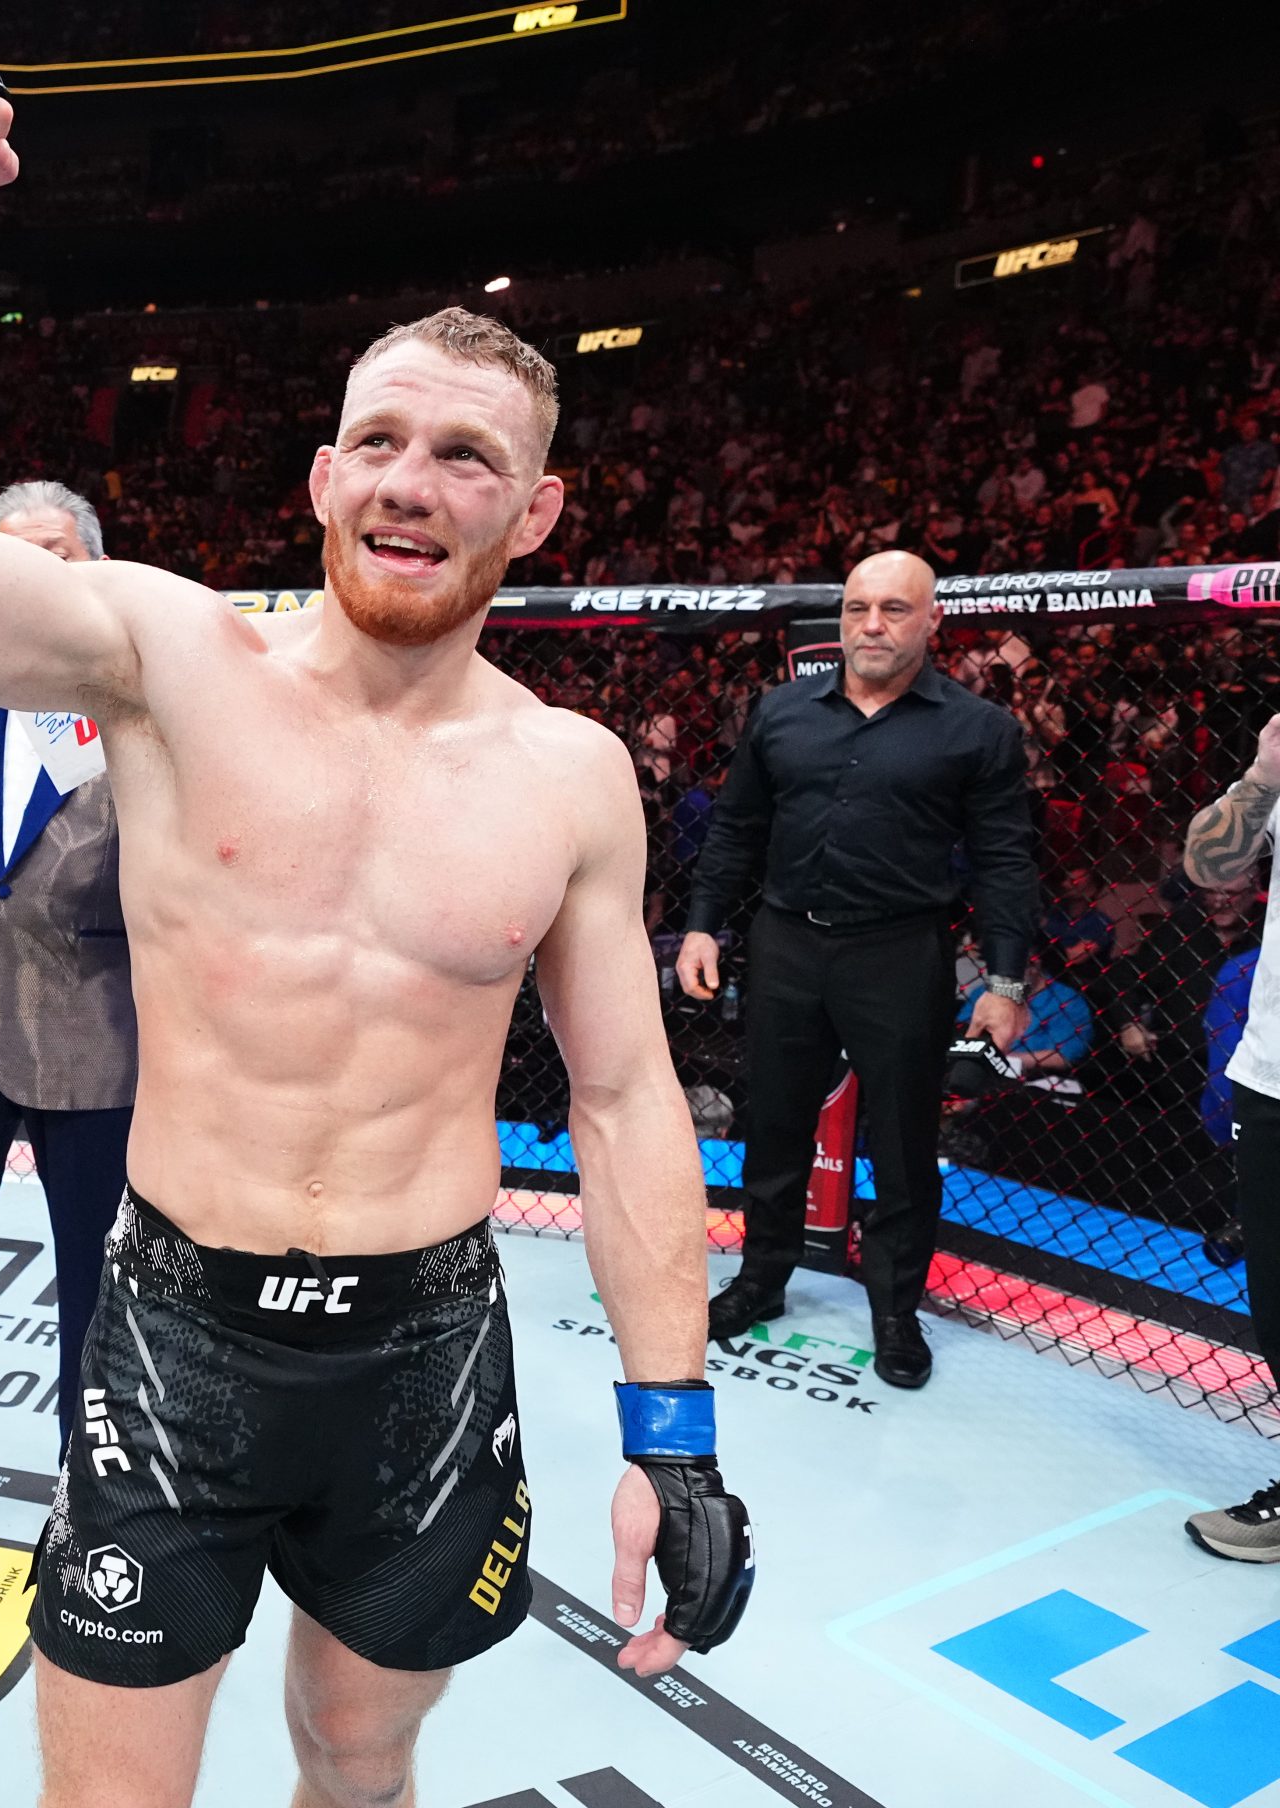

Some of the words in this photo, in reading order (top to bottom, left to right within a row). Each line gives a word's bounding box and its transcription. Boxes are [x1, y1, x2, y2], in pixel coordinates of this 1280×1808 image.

[989, 571, 1112, 591] DROPPED
[570, 589, 767, 612] #GETRIZZ
[1047, 588, 1157, 612] BANANA
[984, 1046, 1008, 1075] UFC
[258, 1275, 360, 1314] UFC
[83, 1388, 132, 1477] UFC
[469, 1479, 531, 1616] DELLA
[60, 1608, 164, 1644] crypto.com
[556, 1603, 623, 1647] ELIZABETH
[556, 1615, 601, 1643] MABIE
[653, 1681, 693, 1708] BATO
[660, 1674, 708, 1706] SCOTT
[732, 1739, 833, 1808] ALTAMIRANO
[758, 1743, 829, 1792] RICHARD
